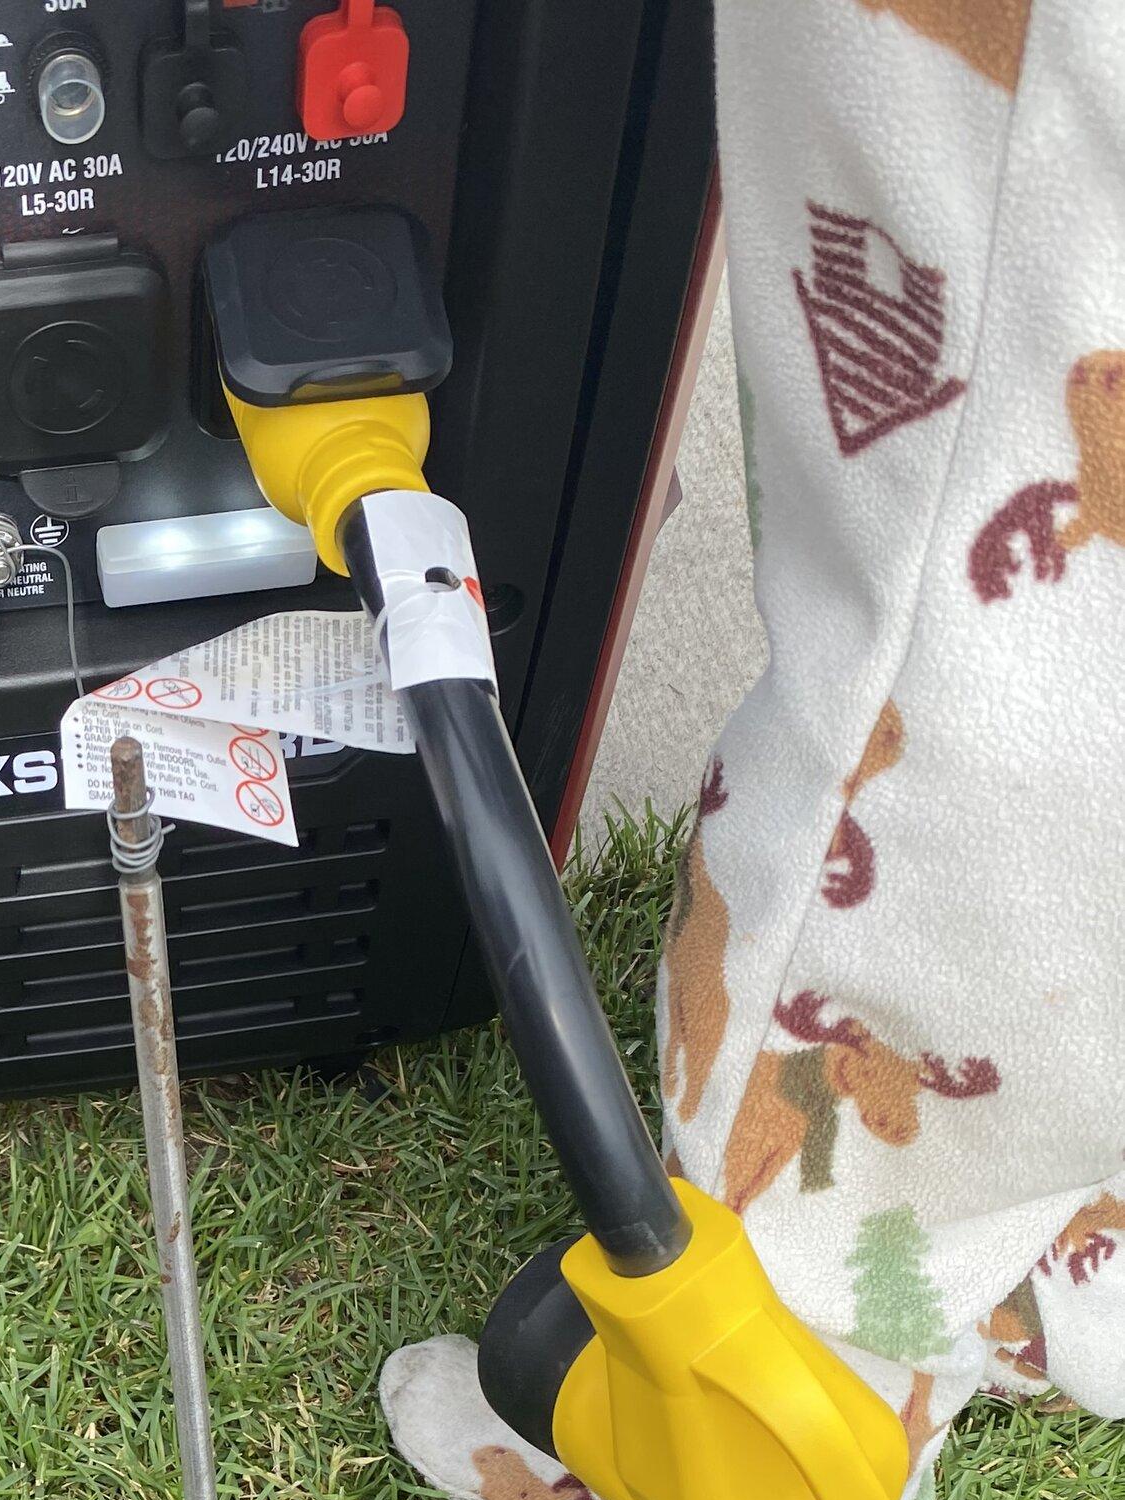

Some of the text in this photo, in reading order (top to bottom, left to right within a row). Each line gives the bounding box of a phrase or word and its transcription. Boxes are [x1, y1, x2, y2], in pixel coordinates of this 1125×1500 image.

[48, 159, 77, 183] AC
[83, 153, 124, 179] 30A
[256, 158, 342, 189] L14-30R
[21, 187, 95, 217] L5-30R
[7, 584, 45, 598] NEUTRE
[84, 725, 111, 735] AFTER
[86, 752, 111, 764] Alway
[88, 779, 99, 788] DO
[158, 787, 177, 799] THIS
[179, 790, 196, 802] TAG
